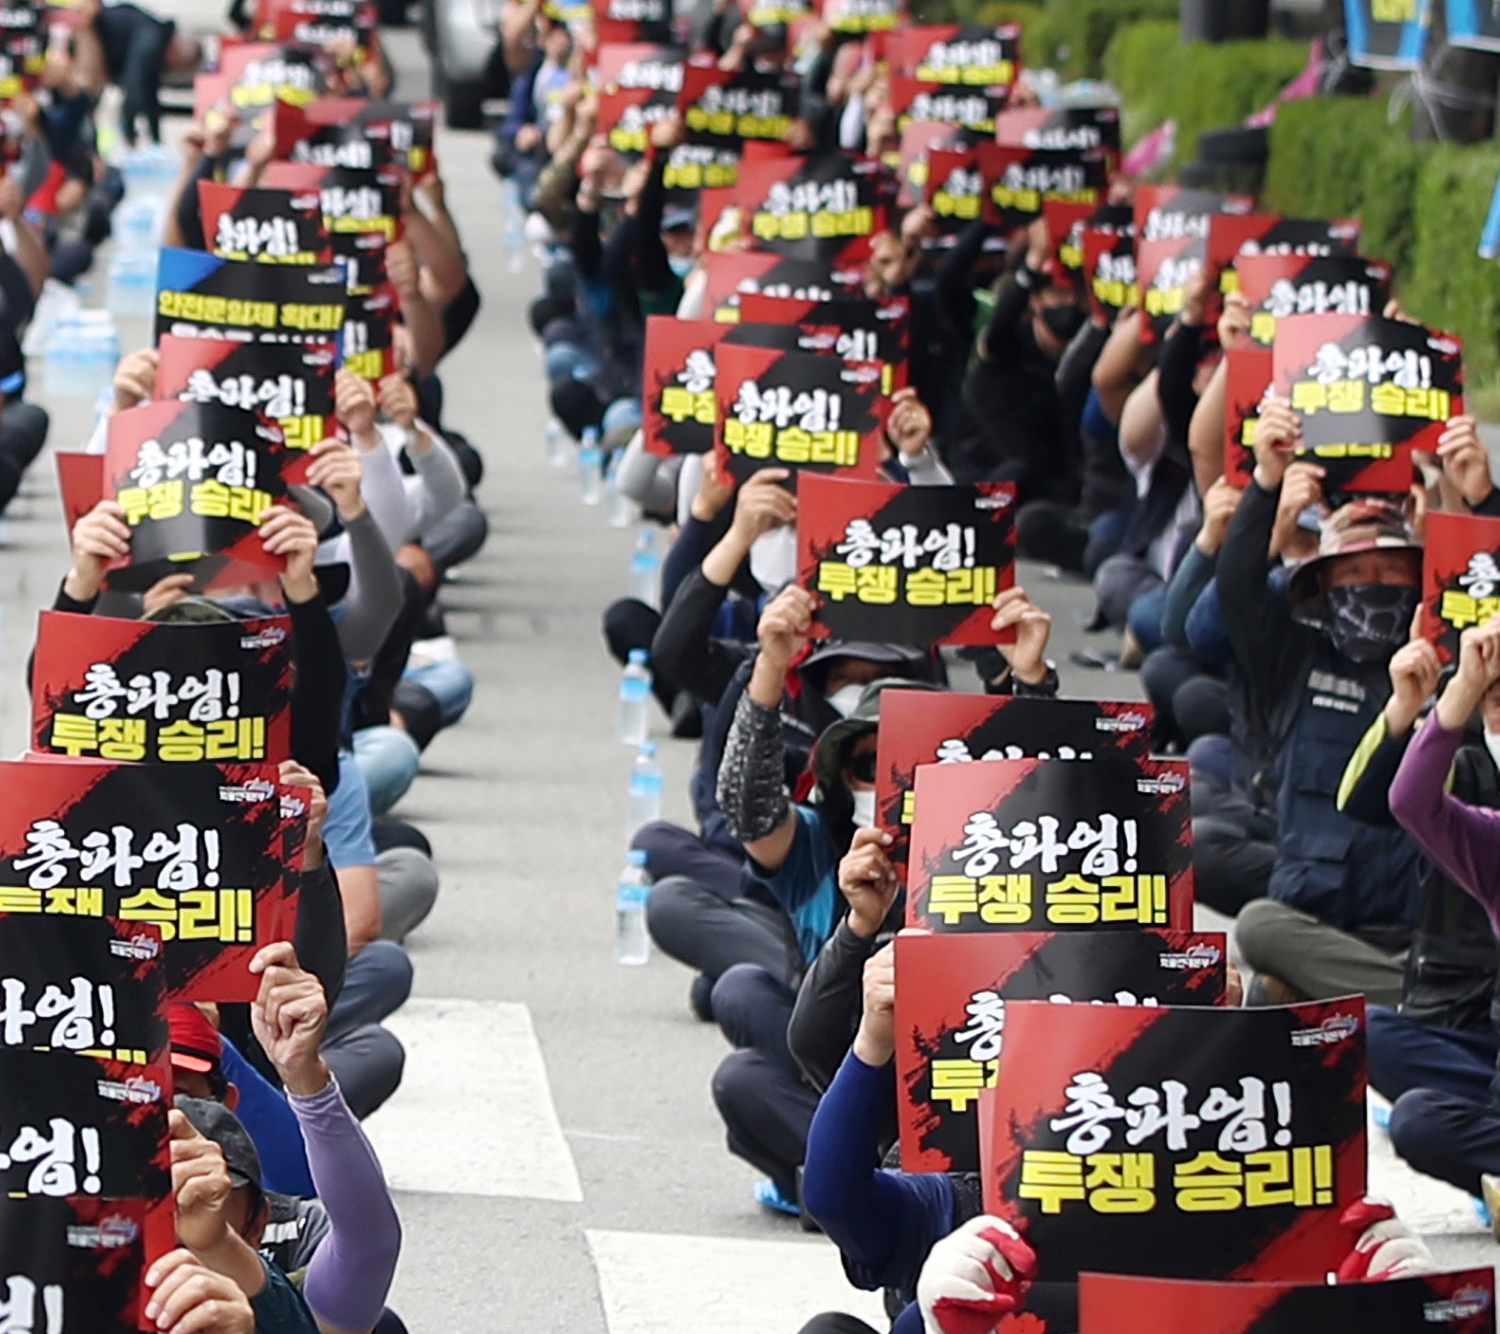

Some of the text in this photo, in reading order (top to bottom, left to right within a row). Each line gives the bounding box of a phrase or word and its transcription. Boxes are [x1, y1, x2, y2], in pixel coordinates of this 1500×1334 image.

[1304, 337, 1434, 389] 총파업!
[734, 380, 839, 433] 총파업!
[1293, 381, 1449, 421] 투쟁 승리!
[128, 434, 255, 489] 총파업!
[724, 424, 859, 465] 투쟁 승리!
[837, 520, 974, 571] 총파업!
[818, 562, 996, 605] 투쟁 승리!
[75, 664, 238, 721] 총파업!
[53, 714, 264, 761] 투쟁 승리!
[14, 821, 218, 890] 총파업!
[948, 812, 1136, 879] 총파업!
[121, 888, 252, 940] 승리!
[936, 875, 1166, 923] 투쟁 승리!
[1051, 1073, 1290, 1154] 총파업!
[1019, 1145, 1332, 1213] 투쟁 승리!
